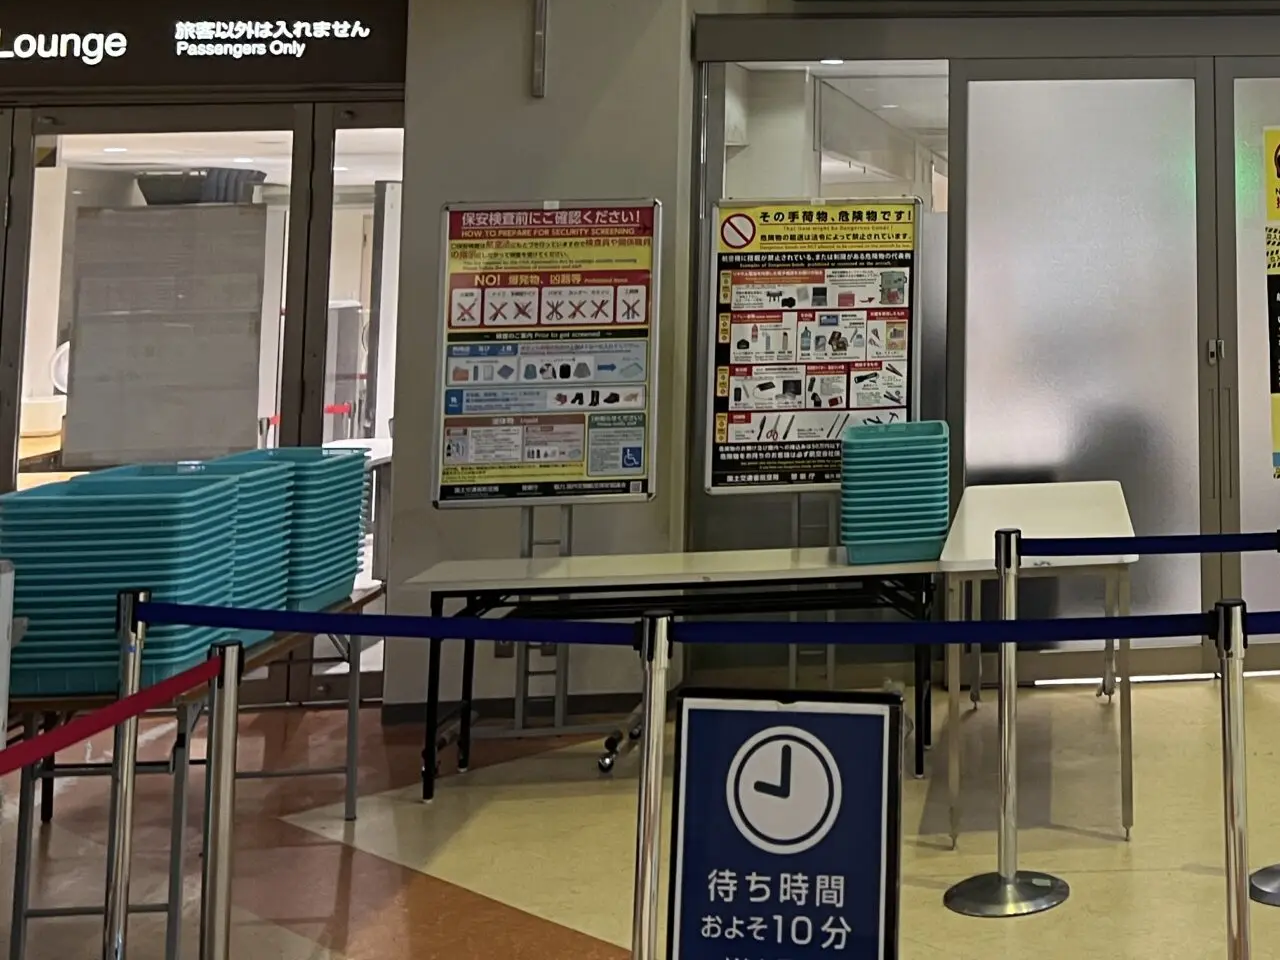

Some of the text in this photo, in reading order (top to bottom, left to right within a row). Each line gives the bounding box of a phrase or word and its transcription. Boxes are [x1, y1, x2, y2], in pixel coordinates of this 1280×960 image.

[175, 21, 370, 40] 旅客以外は入れません
[176, 40, 306, 59] Passengers Only
[462, 210, 640, 226] 保安検査前にご確認ください!
[760, 211, 911, 222] その手荷物、危険物です!
[551, 228, 589, 236] SECURITY
[591, 227, 636, 235] SCREENING
[474, 274, 500, 287] NO!
[707, 868, 845, 908] 待ち時間
[701, 914, 851, 949] およそ10分
